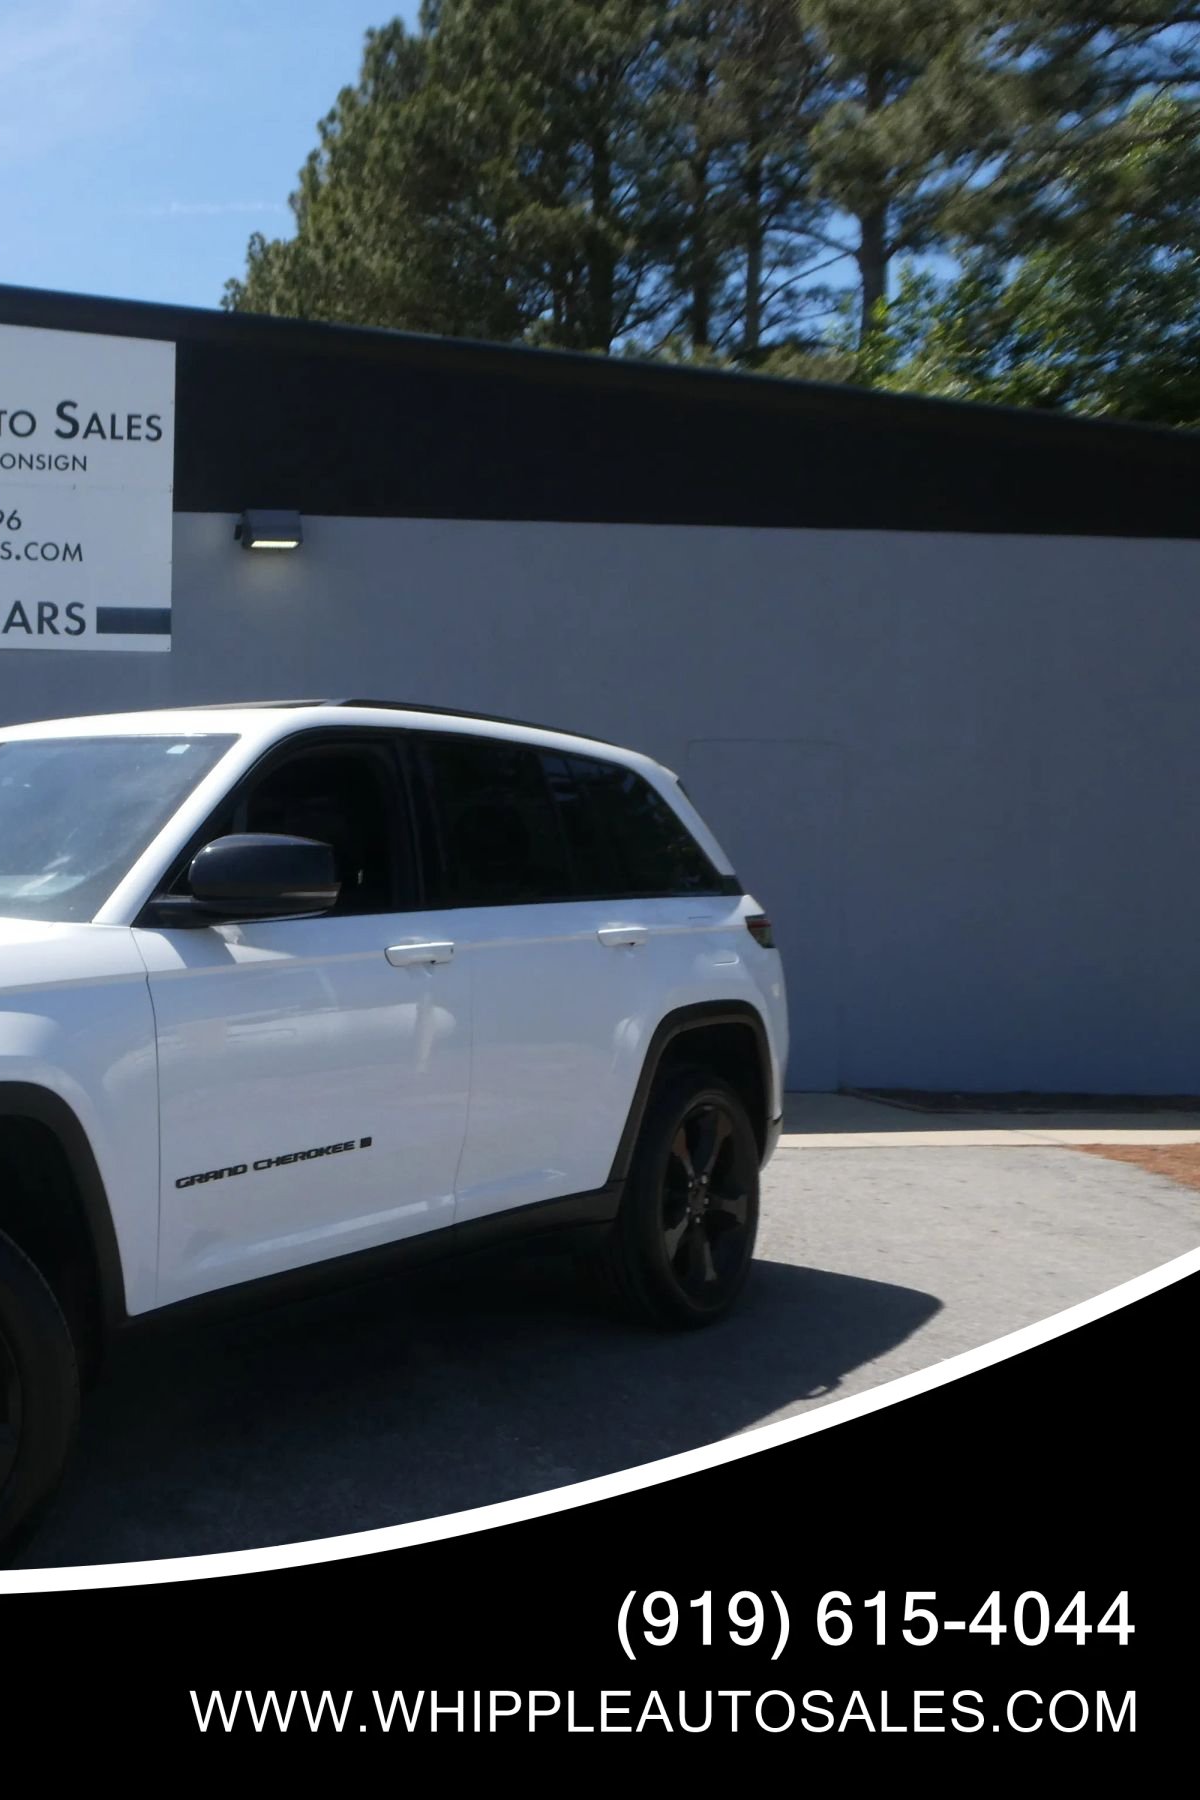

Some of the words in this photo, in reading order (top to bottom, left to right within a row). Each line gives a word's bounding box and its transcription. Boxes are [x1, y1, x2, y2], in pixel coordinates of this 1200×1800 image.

[54, 400, 163, 442] SALES
[175, 1164, 247, 1189] GRAND
[253, 1140, 355, 1171] CHEROKEE
